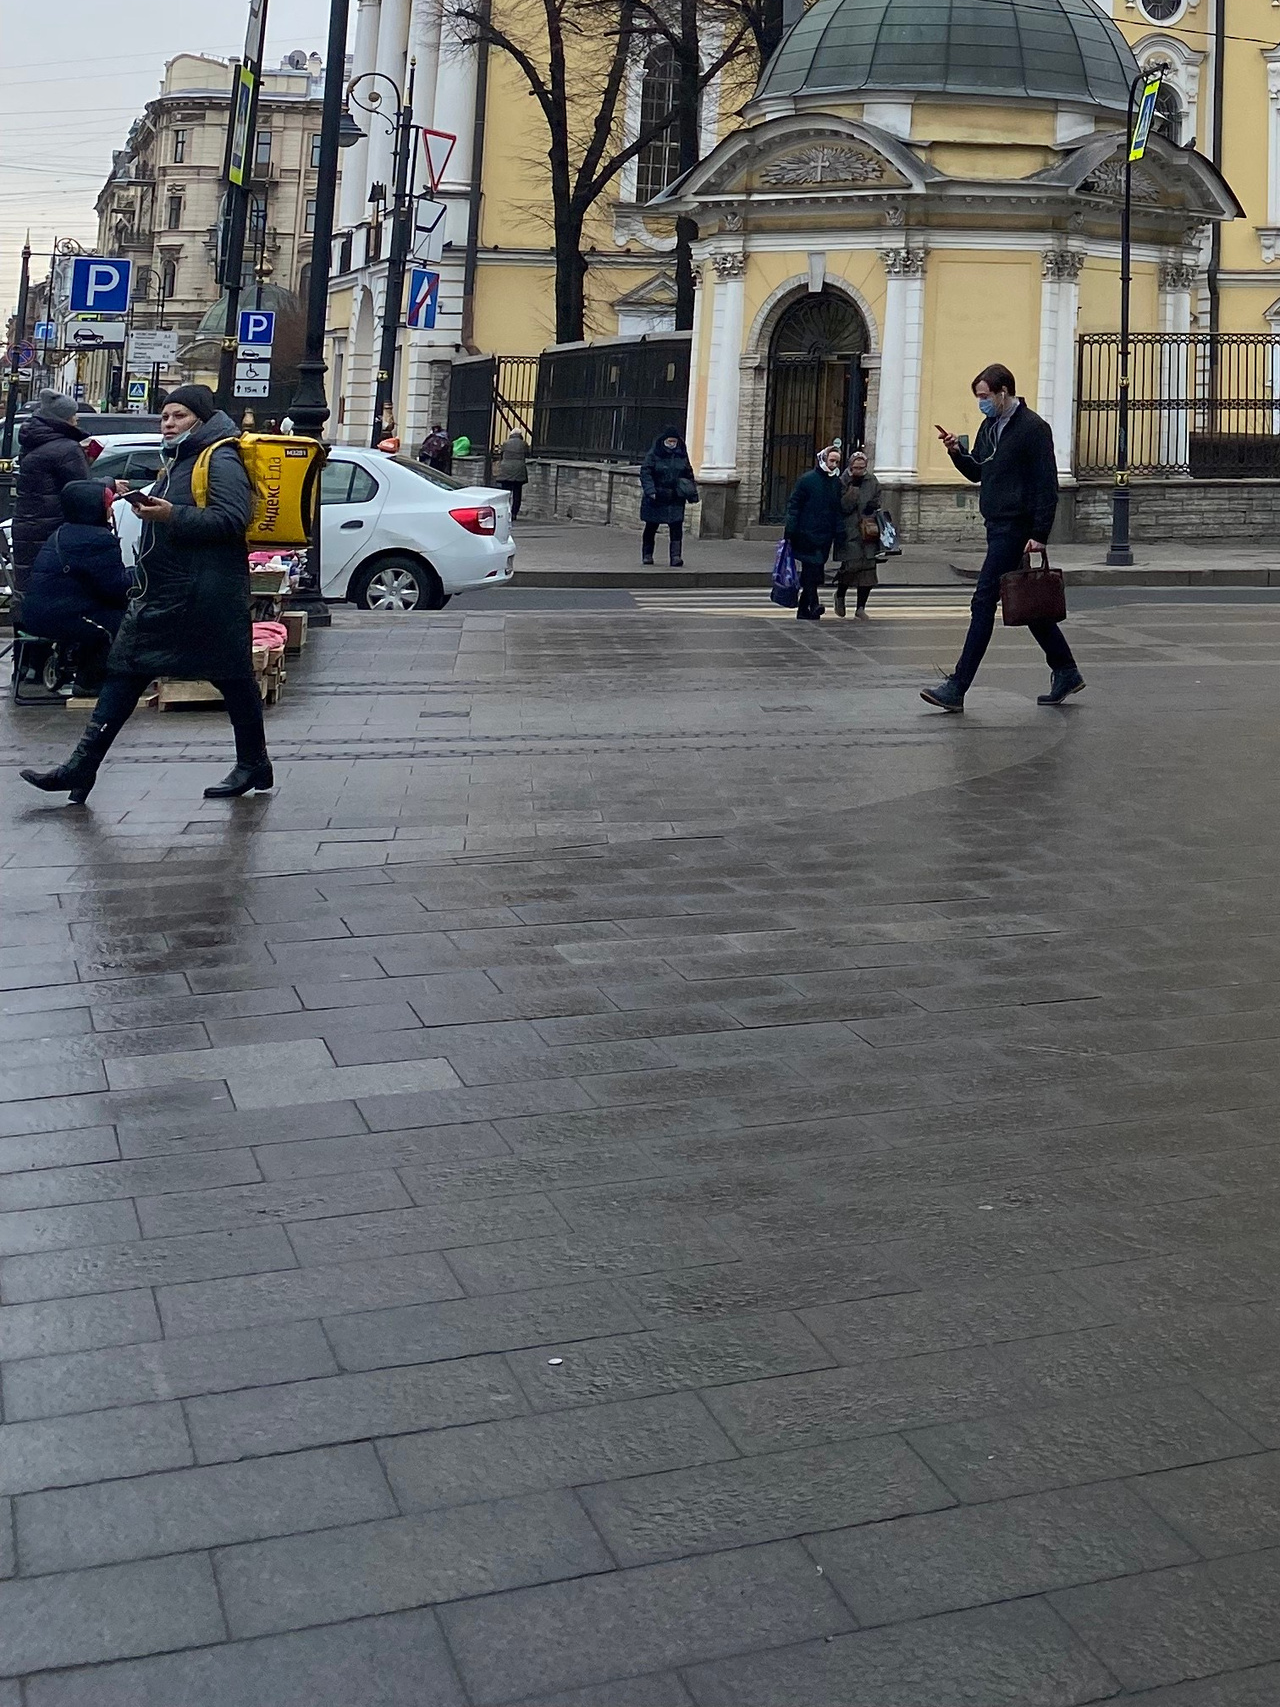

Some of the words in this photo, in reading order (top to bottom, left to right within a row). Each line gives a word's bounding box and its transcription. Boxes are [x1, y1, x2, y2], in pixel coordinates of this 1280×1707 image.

[86, 264, 120, 307] P
[247, 315, 268, 341] P
[257, 484, 281, 532] Яндекс
